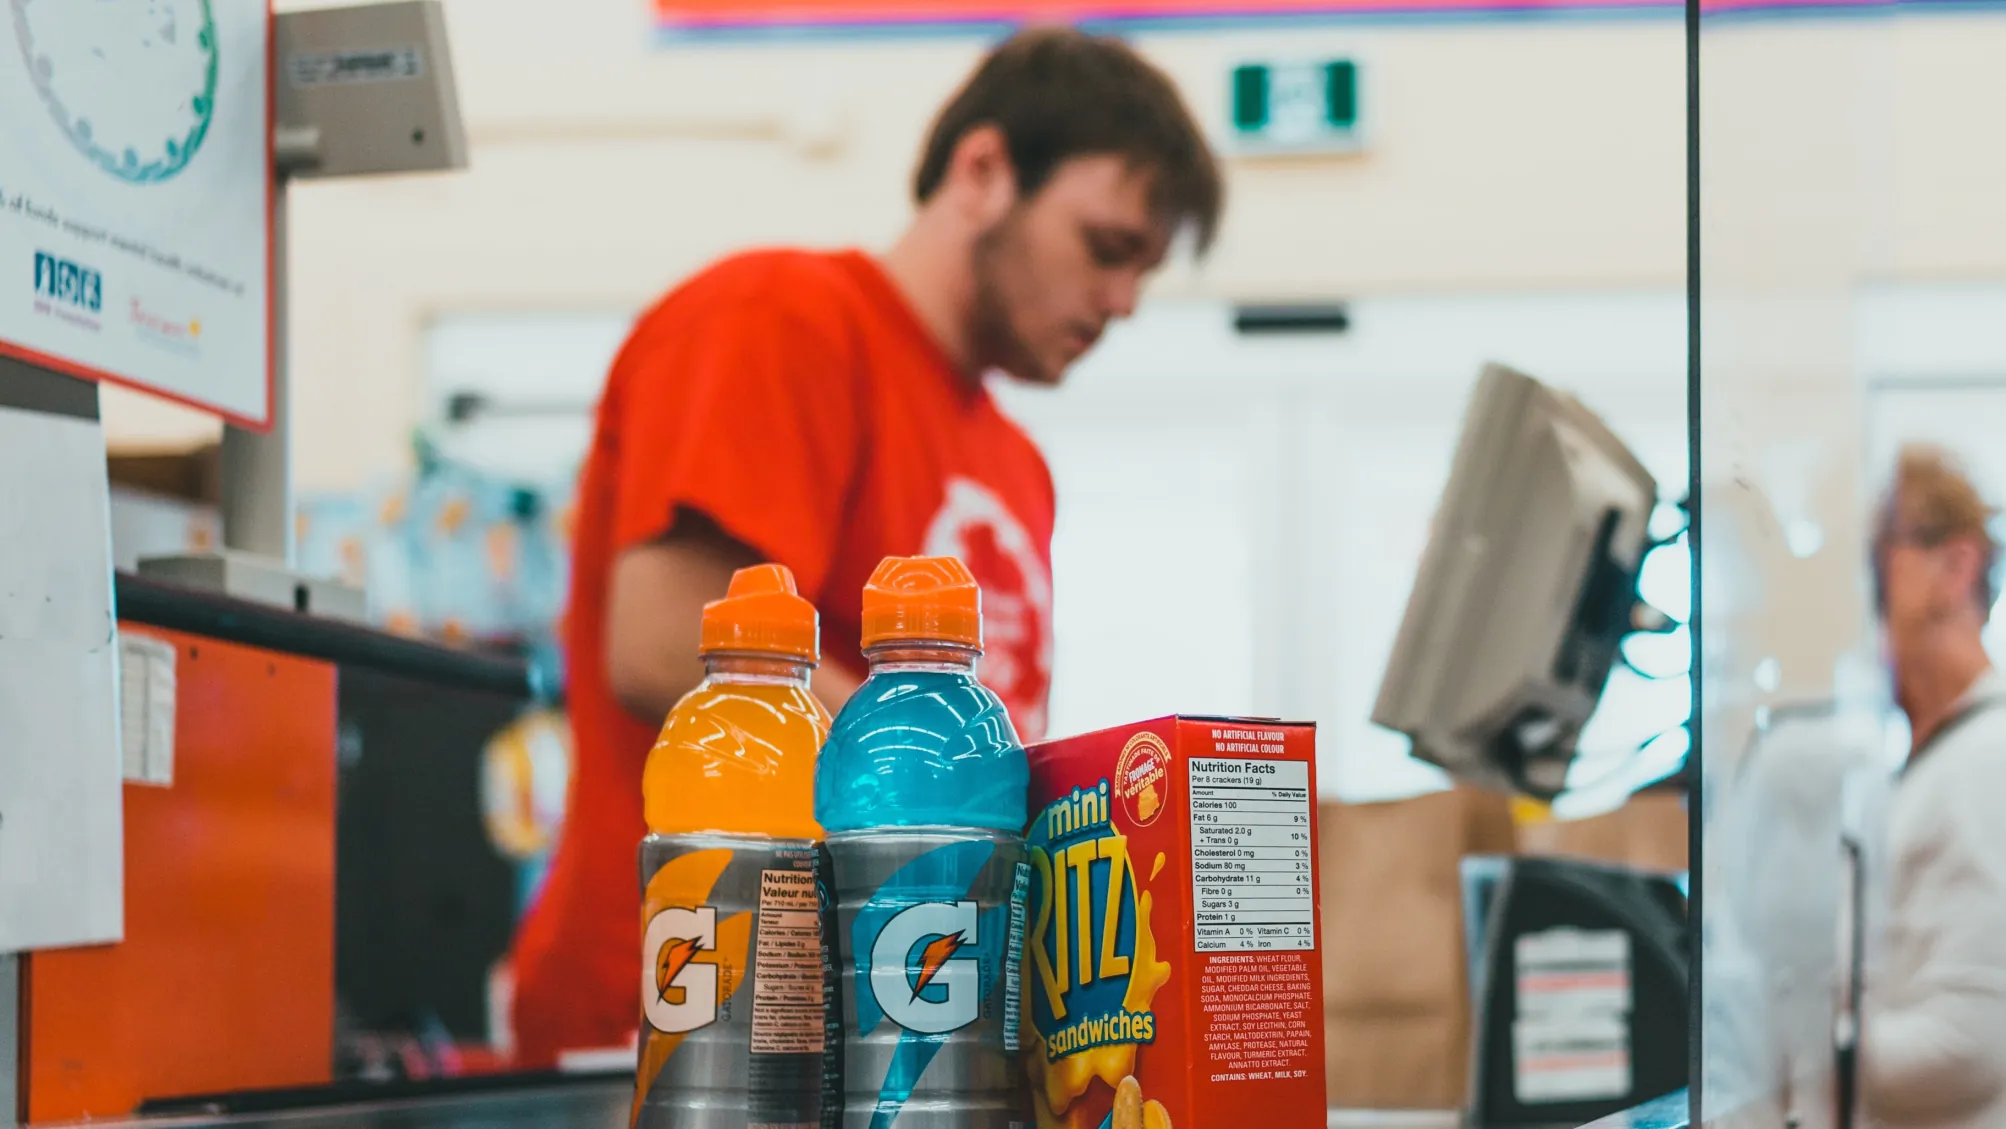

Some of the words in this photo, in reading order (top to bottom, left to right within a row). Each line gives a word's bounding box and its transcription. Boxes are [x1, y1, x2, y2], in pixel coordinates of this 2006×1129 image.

[1212, 730, 1221, 739] NO
[1223, 730, 1256, 740] ARTIFICIAL
[1257, 731, 1284, 741] FLAVOUR
[1215, 742, 1225, 751] NO
[1227, 743, 1259, 753] ARTIFICIAL
[1261, 744, 1284, 754] COLOUR
[1129, 758, 1155, 784] FROMAGE
[1192, 761, 1241, 773] Nutrition
[1245, 763, 1275, 774] Facts
[1124, 768, 1164, 799] véritable
[1243, 777, 1254, 785] (19
[1255, 777, 1262, 785] g)
[1047, 781, 1108, 840] mini
[764, 873, 812, 884] Nutrition
[1195, 875, 1244, 883] Carbohydrate
[763, 887, 799, 897] Valeur
[802, 890, 816, 898] nu
[1201, 900, 1226, 909] Sugars
[1234, 901, 1239, 909] g
[1197, 913, 1222, 921] Protein
[1230, 914, 1235, 922] g
[1257, 927, 1282, 935] Vitamin
[1197, 941, 1226, 949] Calcium
[1258, 940, 1271, 948] Iron
[1210, 955, 1254, 964] INGREDIENTS:
[1256, 955, 1279, 963] WHEAT
[642, 905, 718, 1034] G
[870, 900, 980, 1034] G
[1205, 965, 1237, 973] MODIFIED
[1239, 965, 1257, 973] PALM
[1271, 964, 1307, 972] VEGETABLE
[1202, 975, 1215, 984] OIL,
[1216, 975, 1247, 983] MODIFIED
[1266, 974, 1310, 982] INGREDIENTS,
[1201, 985, 1226, 993] SUGAR,
[1228, 984, 1259, 992] CHEDDAR
[1287, 983, 1311, 991] BAKING
[1223, 994, 1272, 1002] MONOCALCIUM
[1203, 1004, 1244, 1012] AMMONIUM
[1213, 1013, 1240, 1022] SODIUM
[1283, 1011, 1302, 1019] YEAST
[1243, 1022, 1256, 1030] SOY
[1048, 1009, 1153, 1058] sandwiches
[1279, 1039, 1308, 1047] NATURAL
[1243, 1050, 1276, 1058] TURMERIC
[1228, 1060, 1260, 1069] ANNATTO
[1211, 1073, 1247, 1081] CONTAINS:
